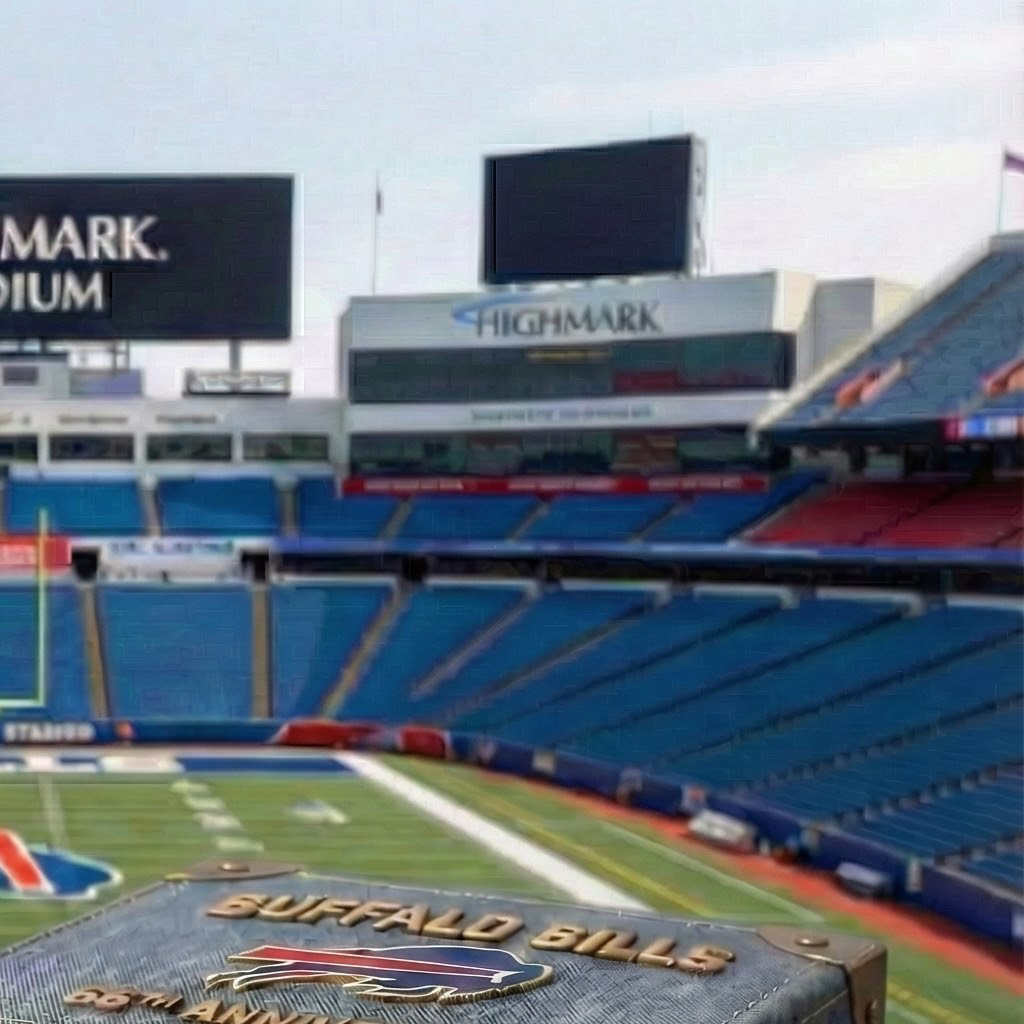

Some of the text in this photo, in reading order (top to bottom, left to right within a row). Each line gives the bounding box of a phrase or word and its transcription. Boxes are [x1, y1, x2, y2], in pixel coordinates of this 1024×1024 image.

[476, 301, 663, 338] HIGHMARK
[207, 894, 736, 974] BUFFALO BILLS
